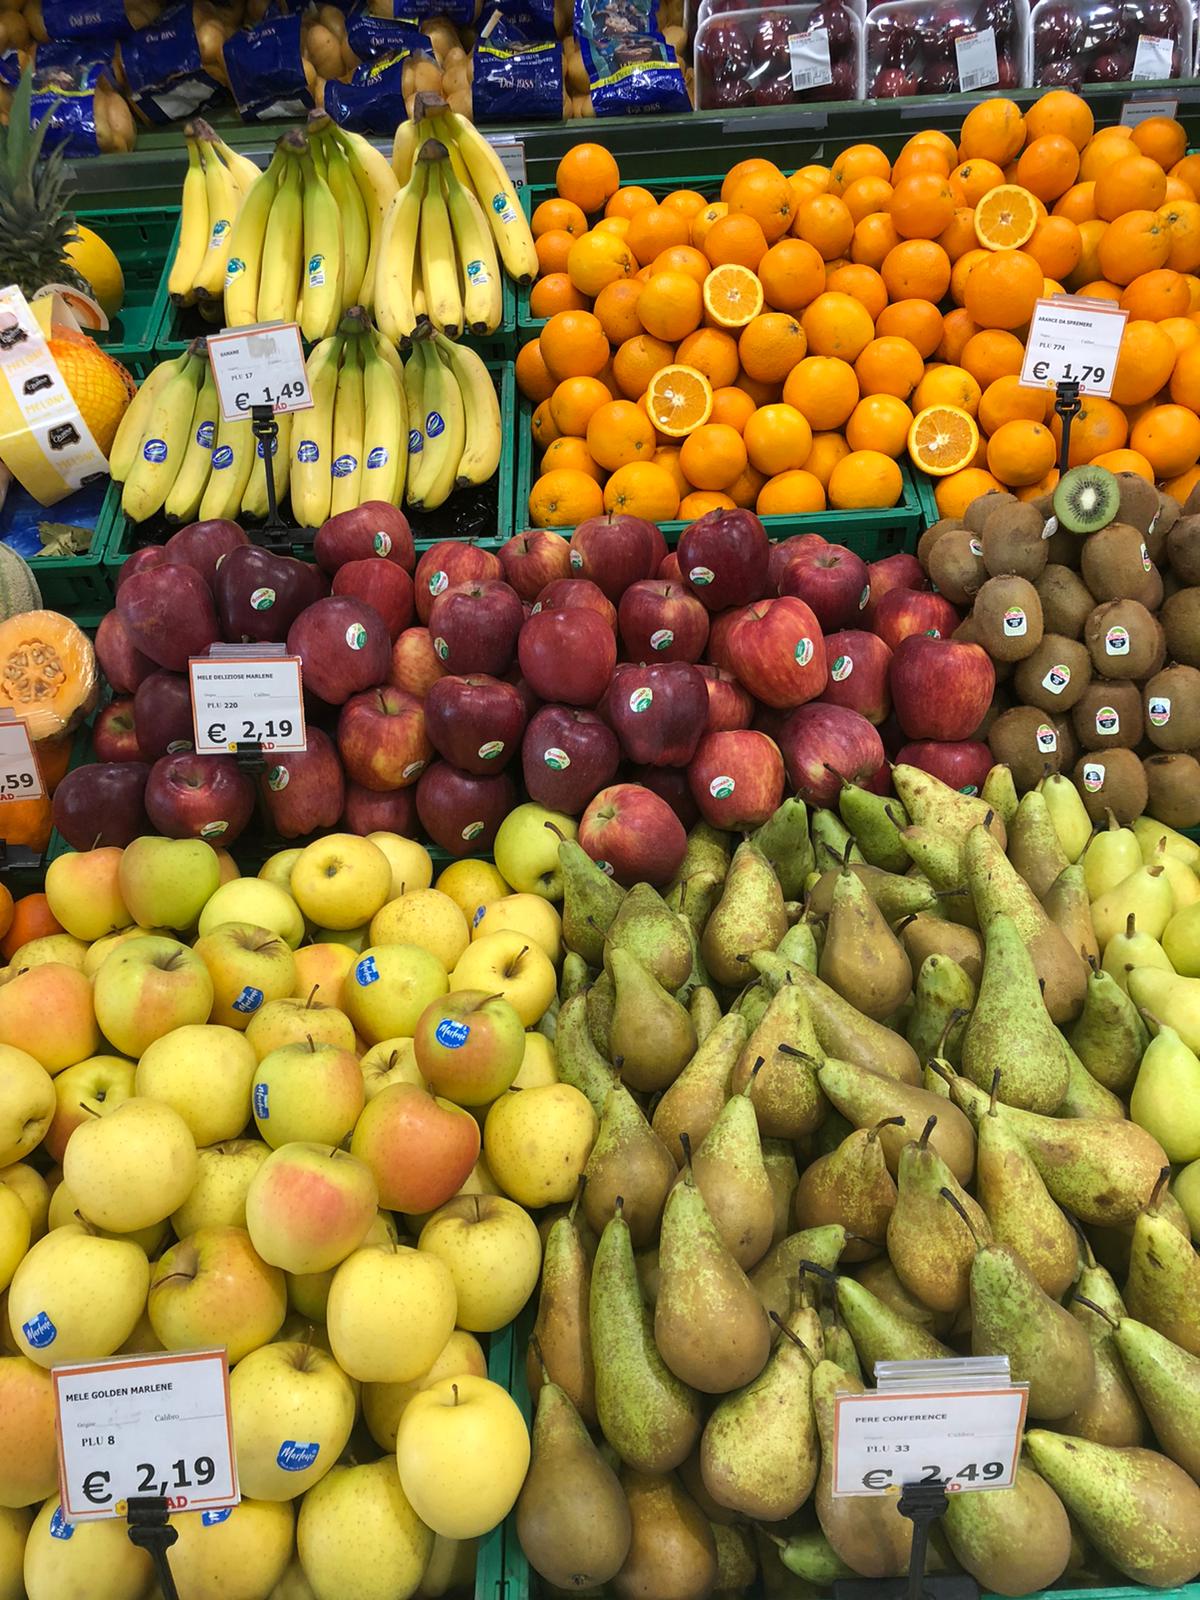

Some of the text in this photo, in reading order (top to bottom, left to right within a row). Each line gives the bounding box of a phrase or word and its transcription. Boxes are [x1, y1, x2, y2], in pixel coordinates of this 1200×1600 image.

[1039, 316, 1058, 324] ARANCE
[1066, 319, 1093, 328] SPREMERE
[1033, 361, 1106, 383] € 1,79
[235, 392, 252, 411] €
[262, 381, 305, 405] 1,49
[207, 720, 293, 743] € 2,19
[0, 773, 34, 793] ,59
[439, 1024, 466, 1041] Marlene
[66, 1383, 173, 1402] MELE GOLDEN MARLENE
[882, 1414, 948, 1423] CONFERENCE
[82, 1436, 115, 1447] PLU 8
[866, 1444, 910, 1453] PLU 33
[82, 1456, 215, 1504] € 2,19
[862, 1462, 1005, 1490] € 2,49
